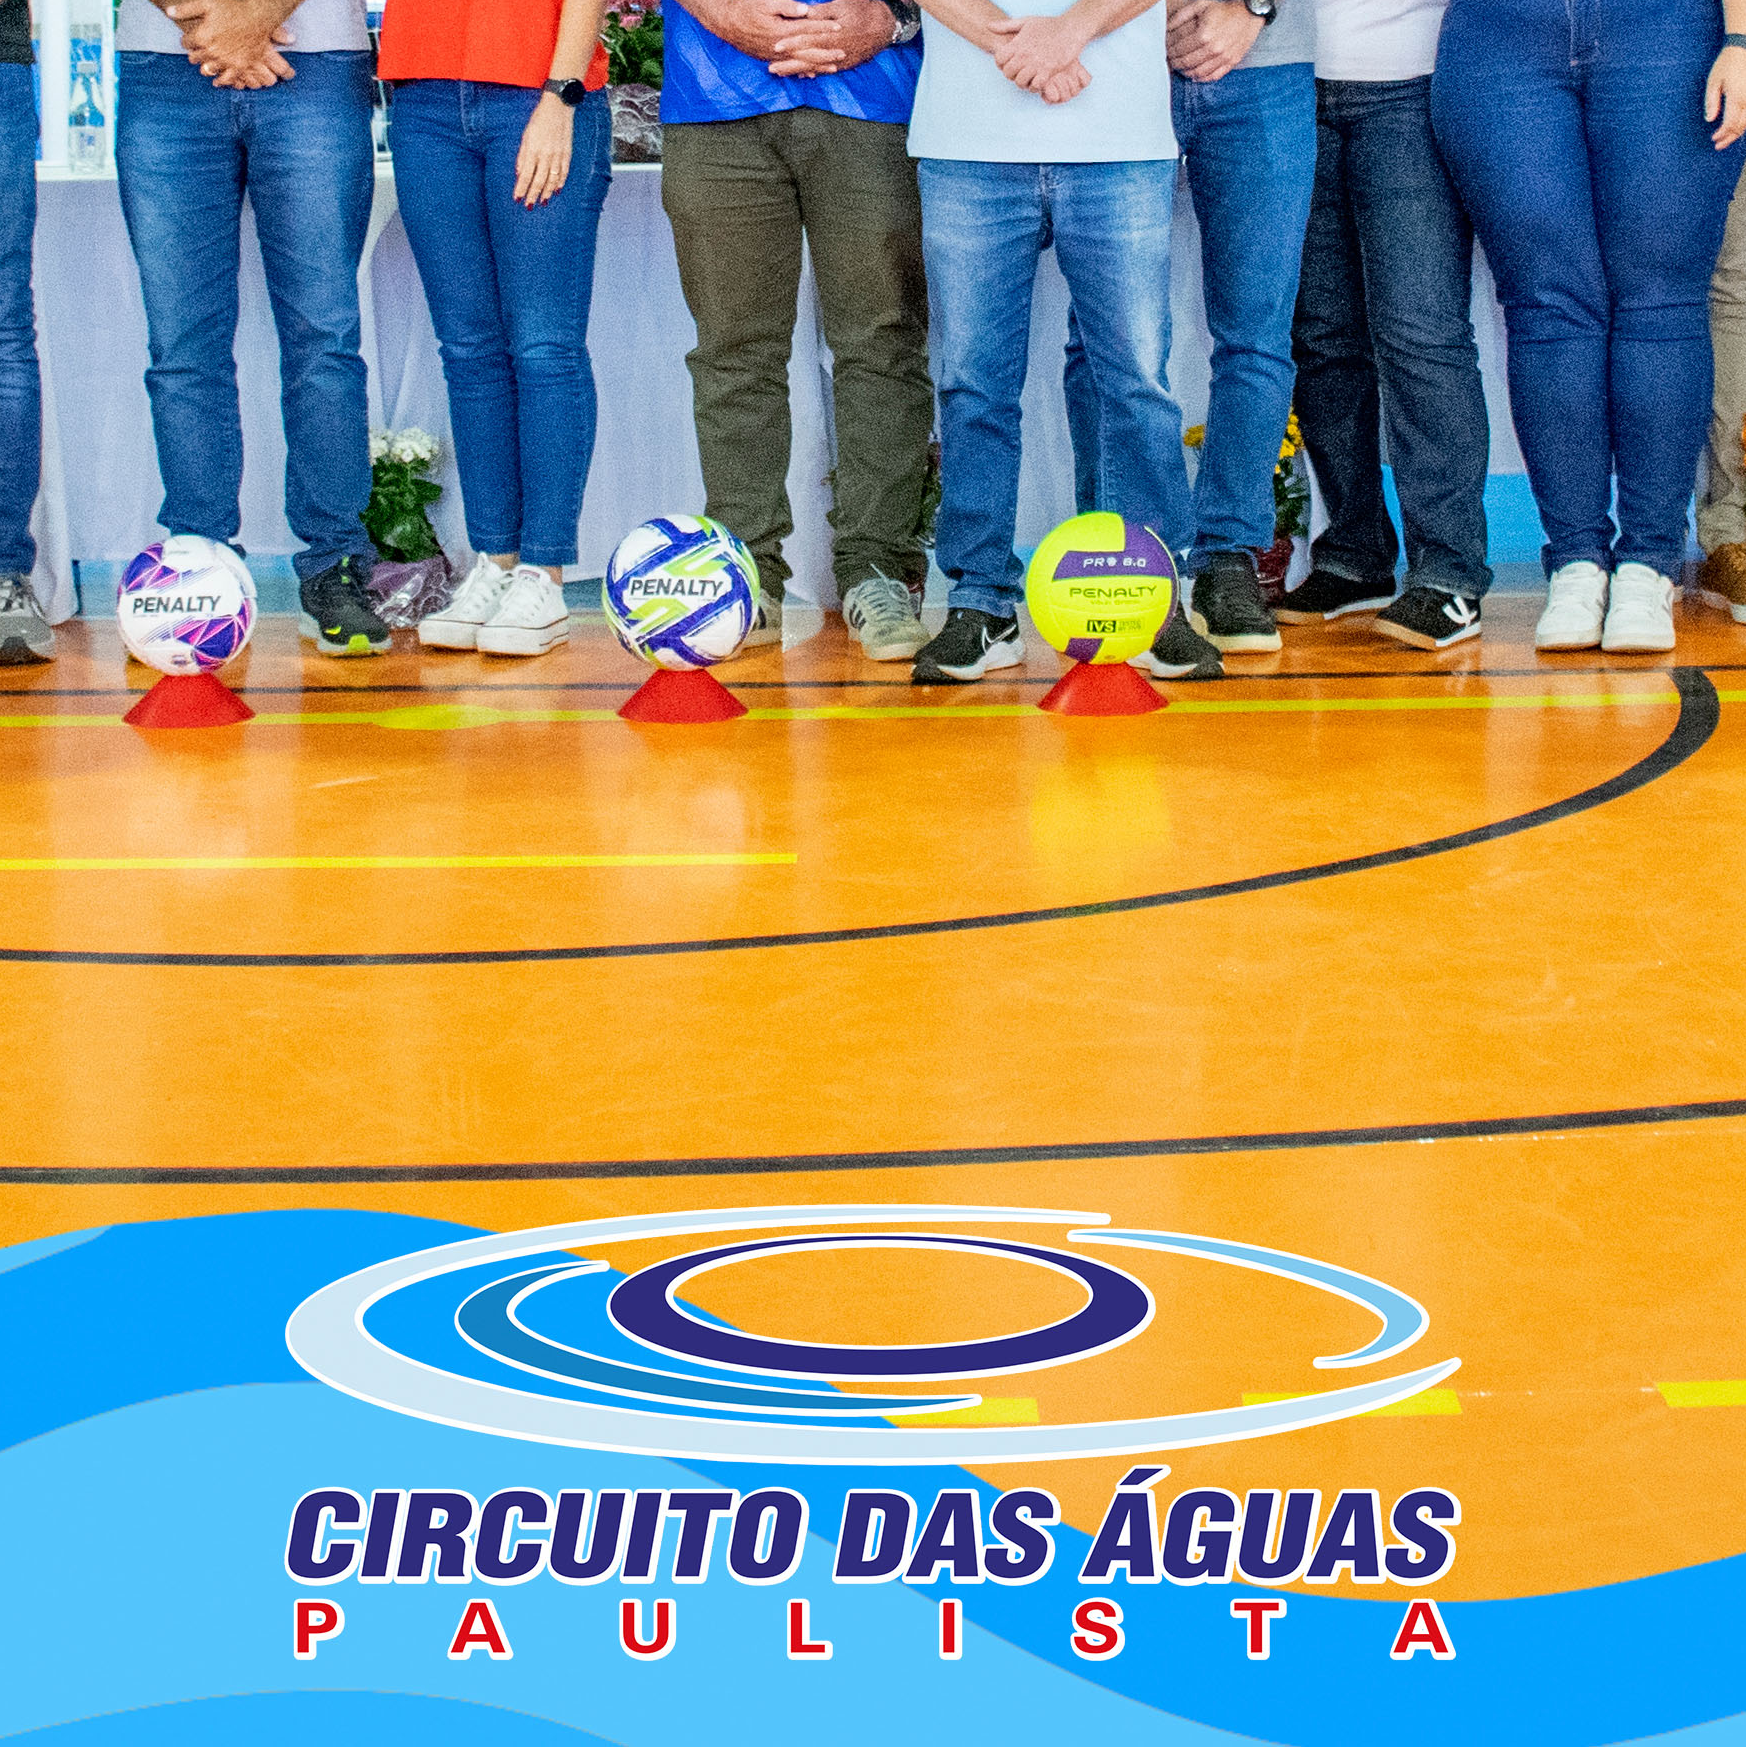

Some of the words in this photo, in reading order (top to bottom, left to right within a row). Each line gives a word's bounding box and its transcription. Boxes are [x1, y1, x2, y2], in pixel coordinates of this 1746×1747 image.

[630, 578, 724, 597] PENALTY
[1069, 586, 1157, 599] PENALTY
[133, 595, 221, 614] PENALTY
